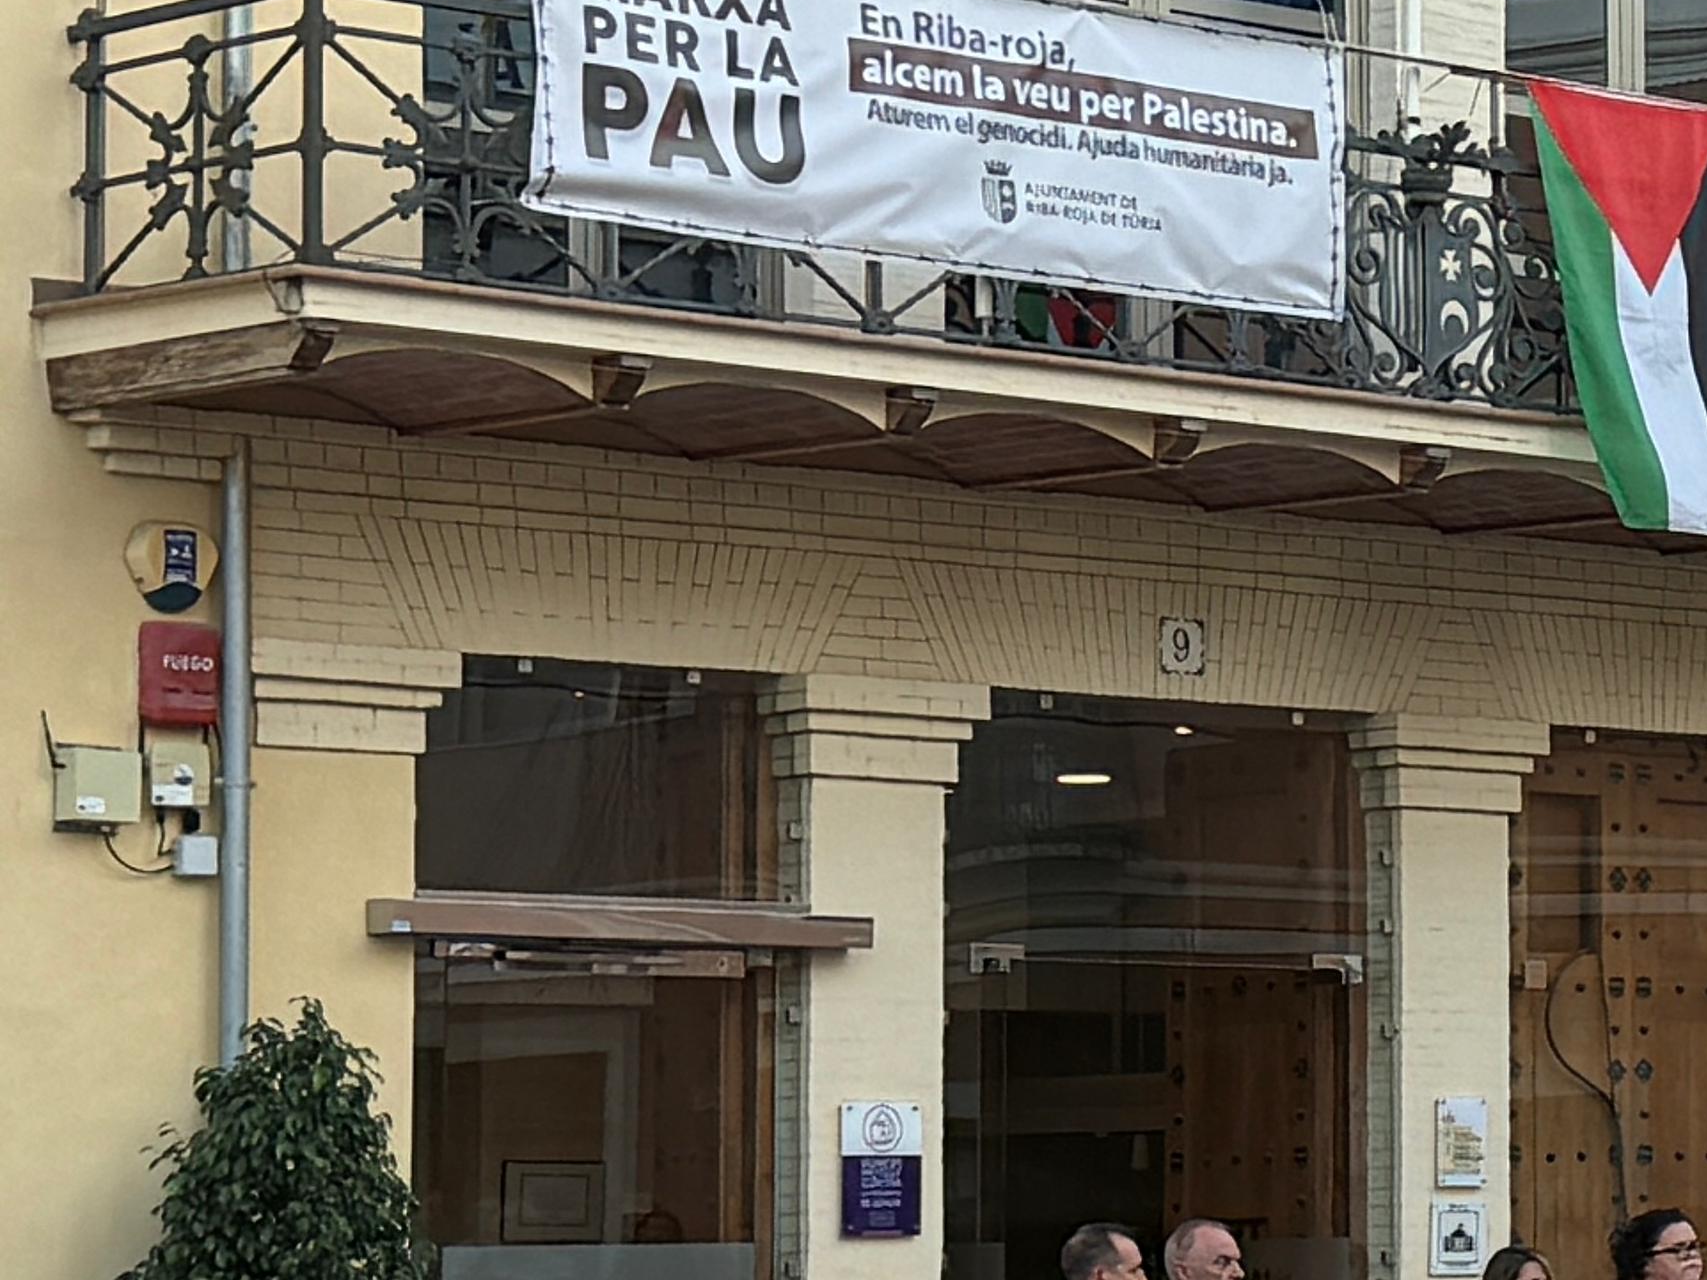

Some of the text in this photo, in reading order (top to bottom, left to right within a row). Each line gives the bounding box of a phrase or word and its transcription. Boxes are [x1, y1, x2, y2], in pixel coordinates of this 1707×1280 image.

[582, 4, 800, 87] PER LA
[860, 3, 1076, 73] En Riba-roja,
[582, 62, 806, 184] PAU
[862, 49, 1298, 148] alcem la veu per Palestina.
[867, 98, 1294, 188] Aturem el genocidi. Ajuda humanitària ja.
[1024, 182, 1117, 208] AJUNTAMENT
[162, 653, 214, 672] FUEGO
[1172, 627, 1190, 663] 9
